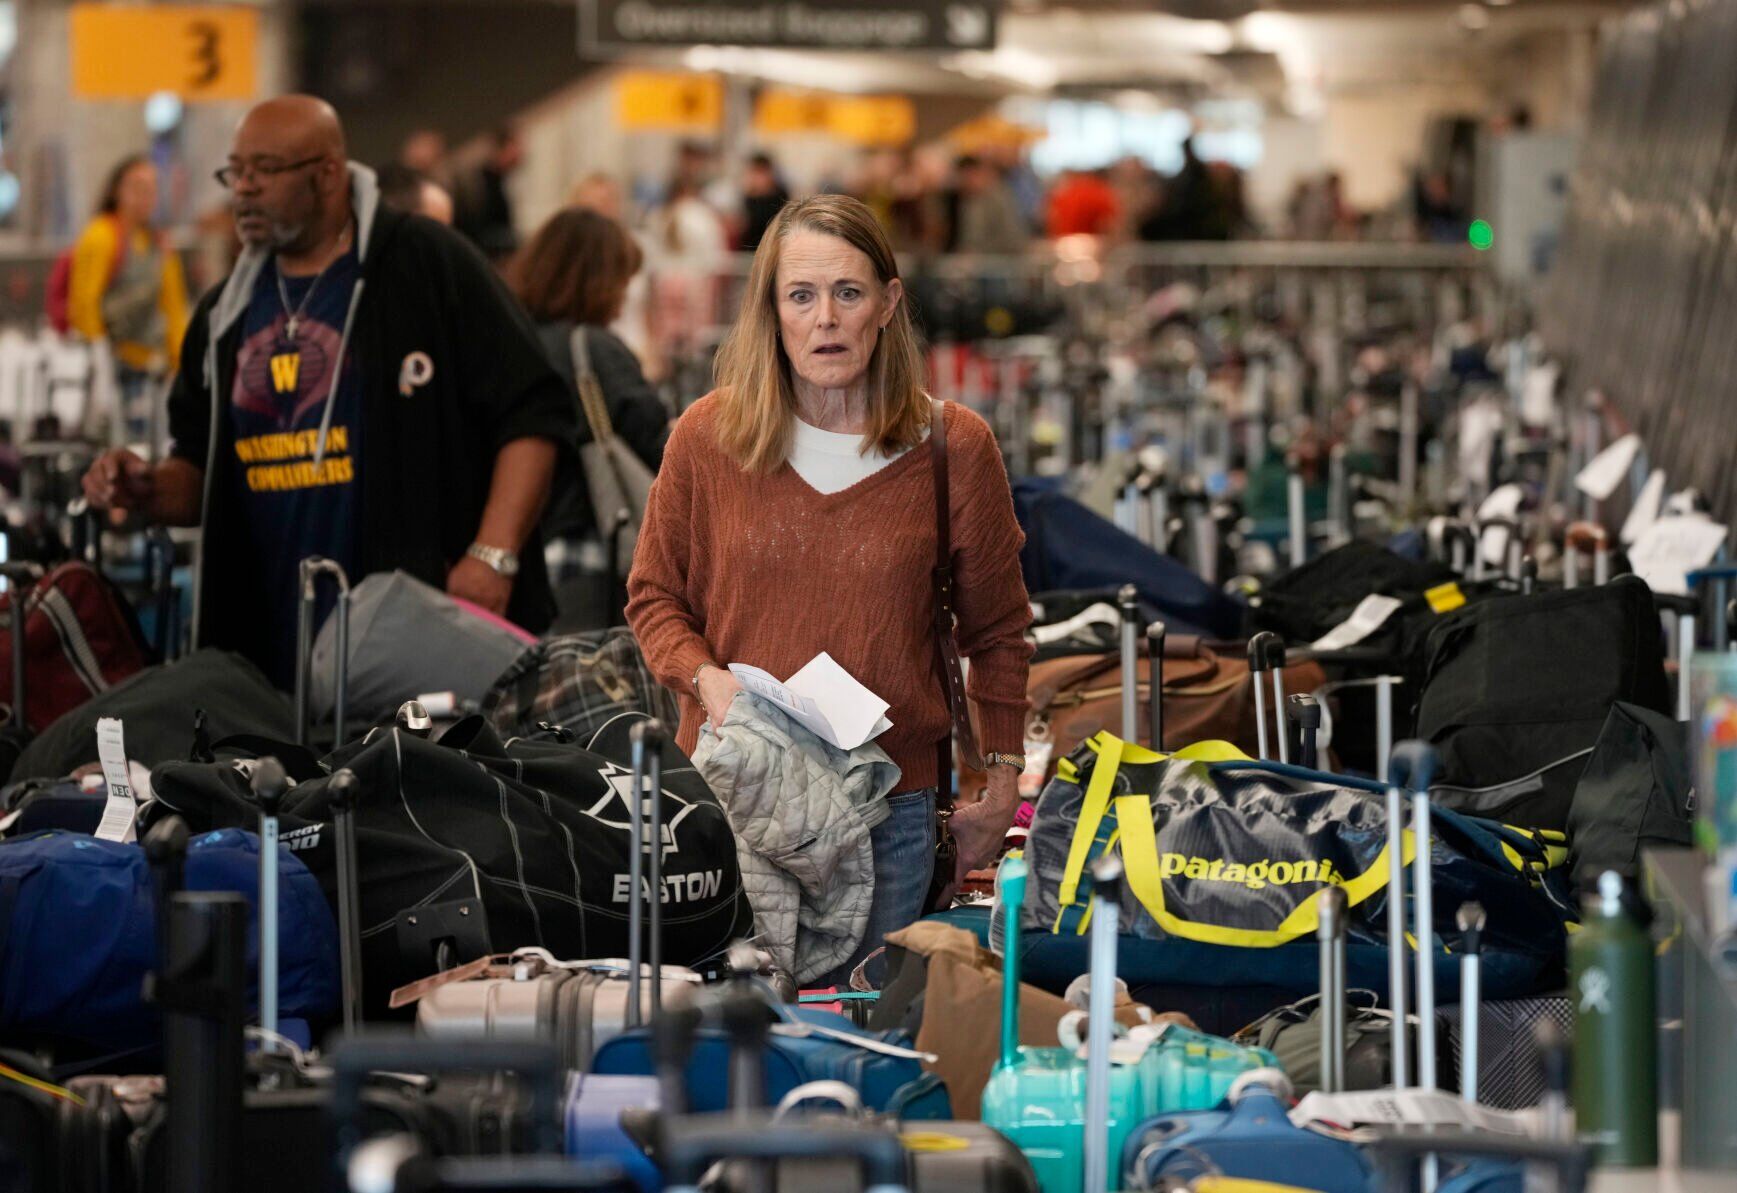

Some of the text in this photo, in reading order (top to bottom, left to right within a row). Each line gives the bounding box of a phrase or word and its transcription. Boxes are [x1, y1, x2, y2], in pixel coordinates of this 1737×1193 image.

[185, 20, 221, 89] 3
[270, 353, 300, 393] W
[278, 822, 324, 841] ERGY
